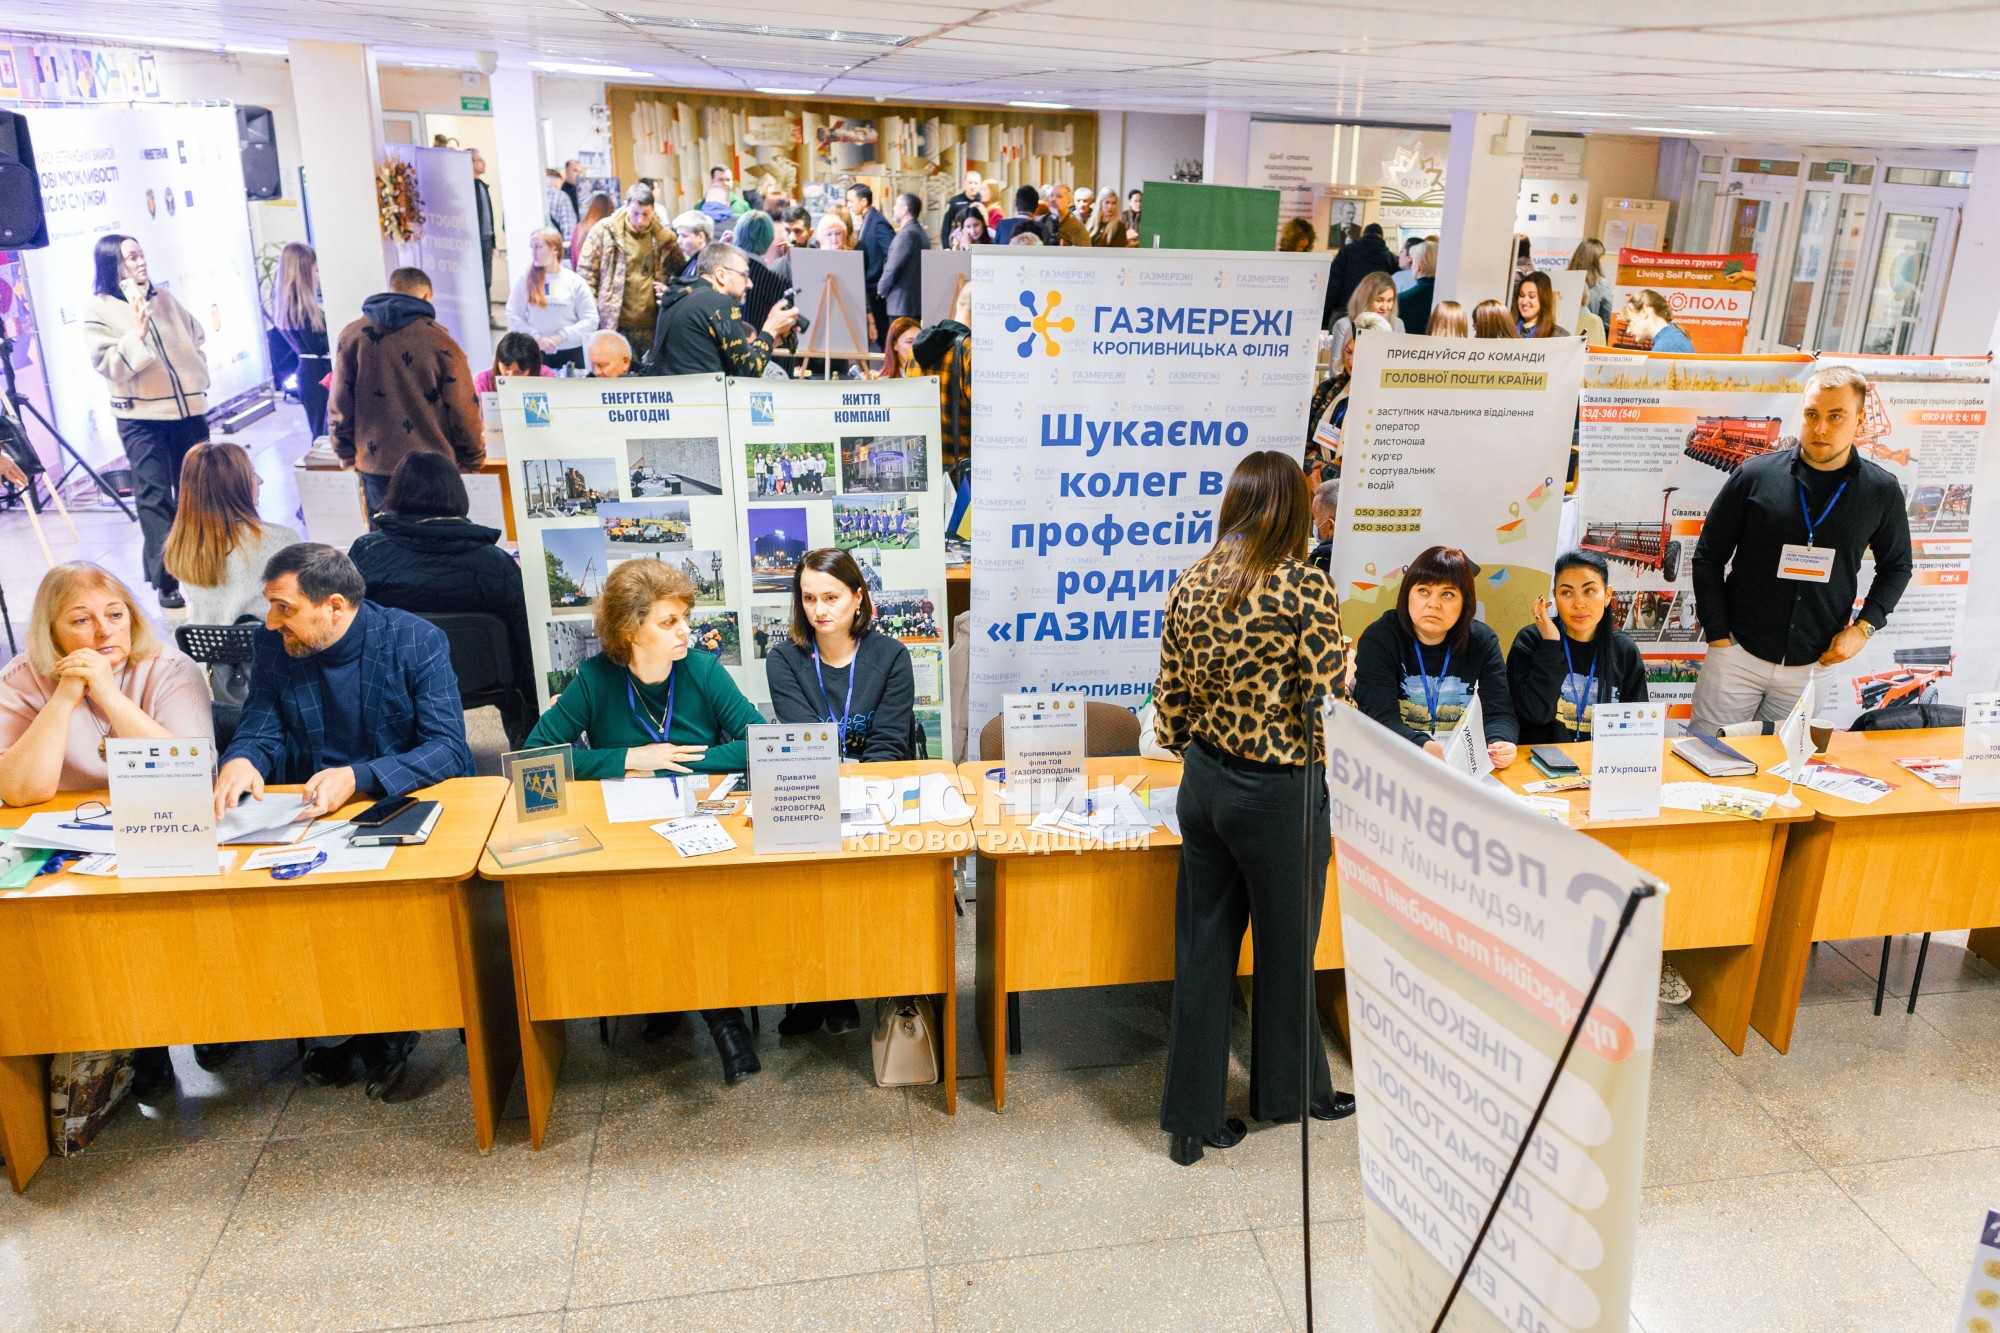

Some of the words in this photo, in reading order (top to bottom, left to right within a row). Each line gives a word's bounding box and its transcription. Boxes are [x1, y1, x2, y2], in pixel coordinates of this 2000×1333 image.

[1631, 255, 1655, 264] Сила
[1657, 257, 1690, 266] живого
[1040, 270, 1095, 279] ГАЗМЕРЕЖІ
[1139, 272, 1193, 281] ГАЗМЕРЕЖІ
[1236, 274, 1289, 284] ГАЗМЕРЕЖІ
[1636, 270, 1664, 280] Living
[1666, 270, 1683, 279] Soil
[1685, 272, 1714, 281] Power
[1094, 306, 1292, 337] ГАЗМЕРЕЖІ
[1093, 341, 1237, 358] КРОПИВНИЦЬКА
[1242, 343, 1289, 357] ФІЛІЯ
[1387, 348, 1465, 361] ПРИЄДНУЙСЯ
[1468, 351, 1485, 362] ДО
[1489, 352, 1545, 363] КОМАНДИ
[974, 370, 1028, 379] ГАЗМЕРЕЖІ
[1072, 371, 1126, 379] ГАЗМЕРЕЖІ
[1168, 372, 1220, 380] ГАЗМЕРЕЖІ
[1385, 371, 1447, 384] ГОЛОВНОЇ
[1450, 374, 1495, 385] ПОШТИ
[1498, 373, 1543, 386] КРАЇНИ
[601, 391, 673, 405] ЕНЕРГЕТИКА
[842, 393, 880, 405] ЖИТТЯ
[1583, 395, 1611, 403] Сівалка
[1613, 397, 1660, 405] зернотукова
[1889, 396, 1928, 405] Культиватор
[608, 409, 670, 423] СЬОГОДНІ
[834, 408, 890, 423] КОМПАНІЇ
[1377, 408, 1425, 418] заступник
[1427, 408, 1482, 417] начальника
[1484, 408, 1534, 418] відділення
[1582, 409, 1618, 419] СЗД-360
[1619, 409, 1640, 420] (540)
[1375, 422, 1420, 432] оператор
[1041, 414, 1248, 457] Шукаємо
[1373, 437, 1425, 446] листоноша
[1371, 452, 1403, 461] кур'єр
[1369, 466, 1435, 476] сортувальник
[1060, 472, 1187, 497] колег
[1199, 471, 1223, 495] в
[1367, 481, 1394, 491] водій
[1355, 508, 1375, 516] 050
[1377, 508, 1396, 516] 360
[1397, 508, 1409, 516] 33
[1411, 508, 1422, 516] 27
[1671, 509, 1701, 517] Сівалка
[1353, 523, 1373, 531] 050
[1375, 523, 1394, 531] 360
[1396, 523, 1408, 531] 33
[1409, 523, 1420, 531] 28
[1012, 510, 1213, 556] професій
[1940, 574, 1960, 582] КЗК-6
[1463, 726, 1478, 774] УКРПОШТА
[522, 764, 555, 773] КІРОВОГРАД
[1011, 767, 1081, 776] «ГАЗОРОЗПОДІЛЬНІ
[1598, 766, 1609, 774] АТ
[1611, 765, 1657, 775] Укрпошта
[777, 774, 816, 782] Приватне
[1014, 777, 1041, 785] МЕРЕЖІ
[774, 795, 820, 803] товариство
[526, 804, 559, 814] ОБЛЕНЕРГО
[771, 804, 825, 812] «КІРОВОГРАД
[154, 812, 173, 820] ПАТ
[773, 814, 823, 822] ОБЛЕНЕРГО»
[119, 825, 147, 834] «РУР
[150, 825, 178, 833] ГРУП
[182, 824, 209, 833] С.А.»
